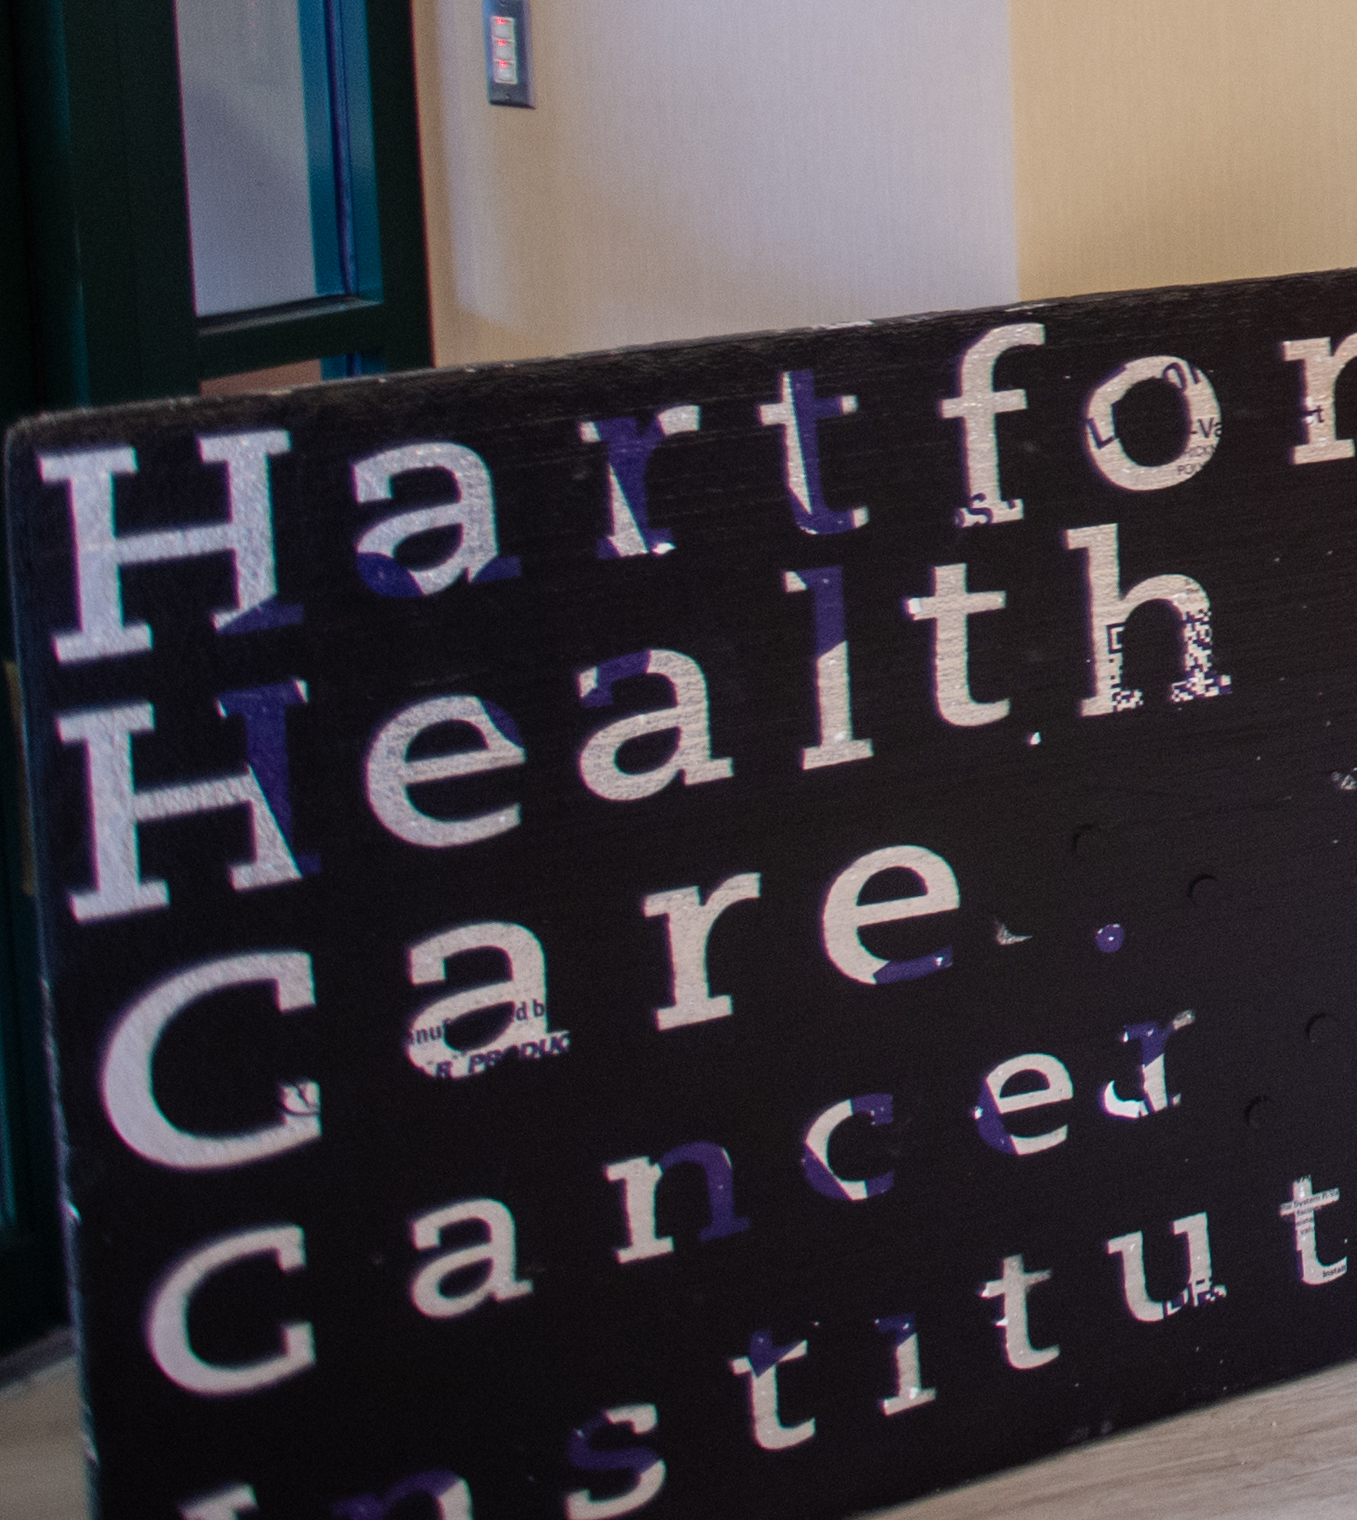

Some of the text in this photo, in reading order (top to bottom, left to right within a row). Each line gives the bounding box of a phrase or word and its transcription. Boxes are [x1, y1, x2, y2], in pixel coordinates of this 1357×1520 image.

[55, 523, 1232, 924] Health
[102, 845, 961, 1172] Care
[147, 1009, 1196, 1396] Cancer
